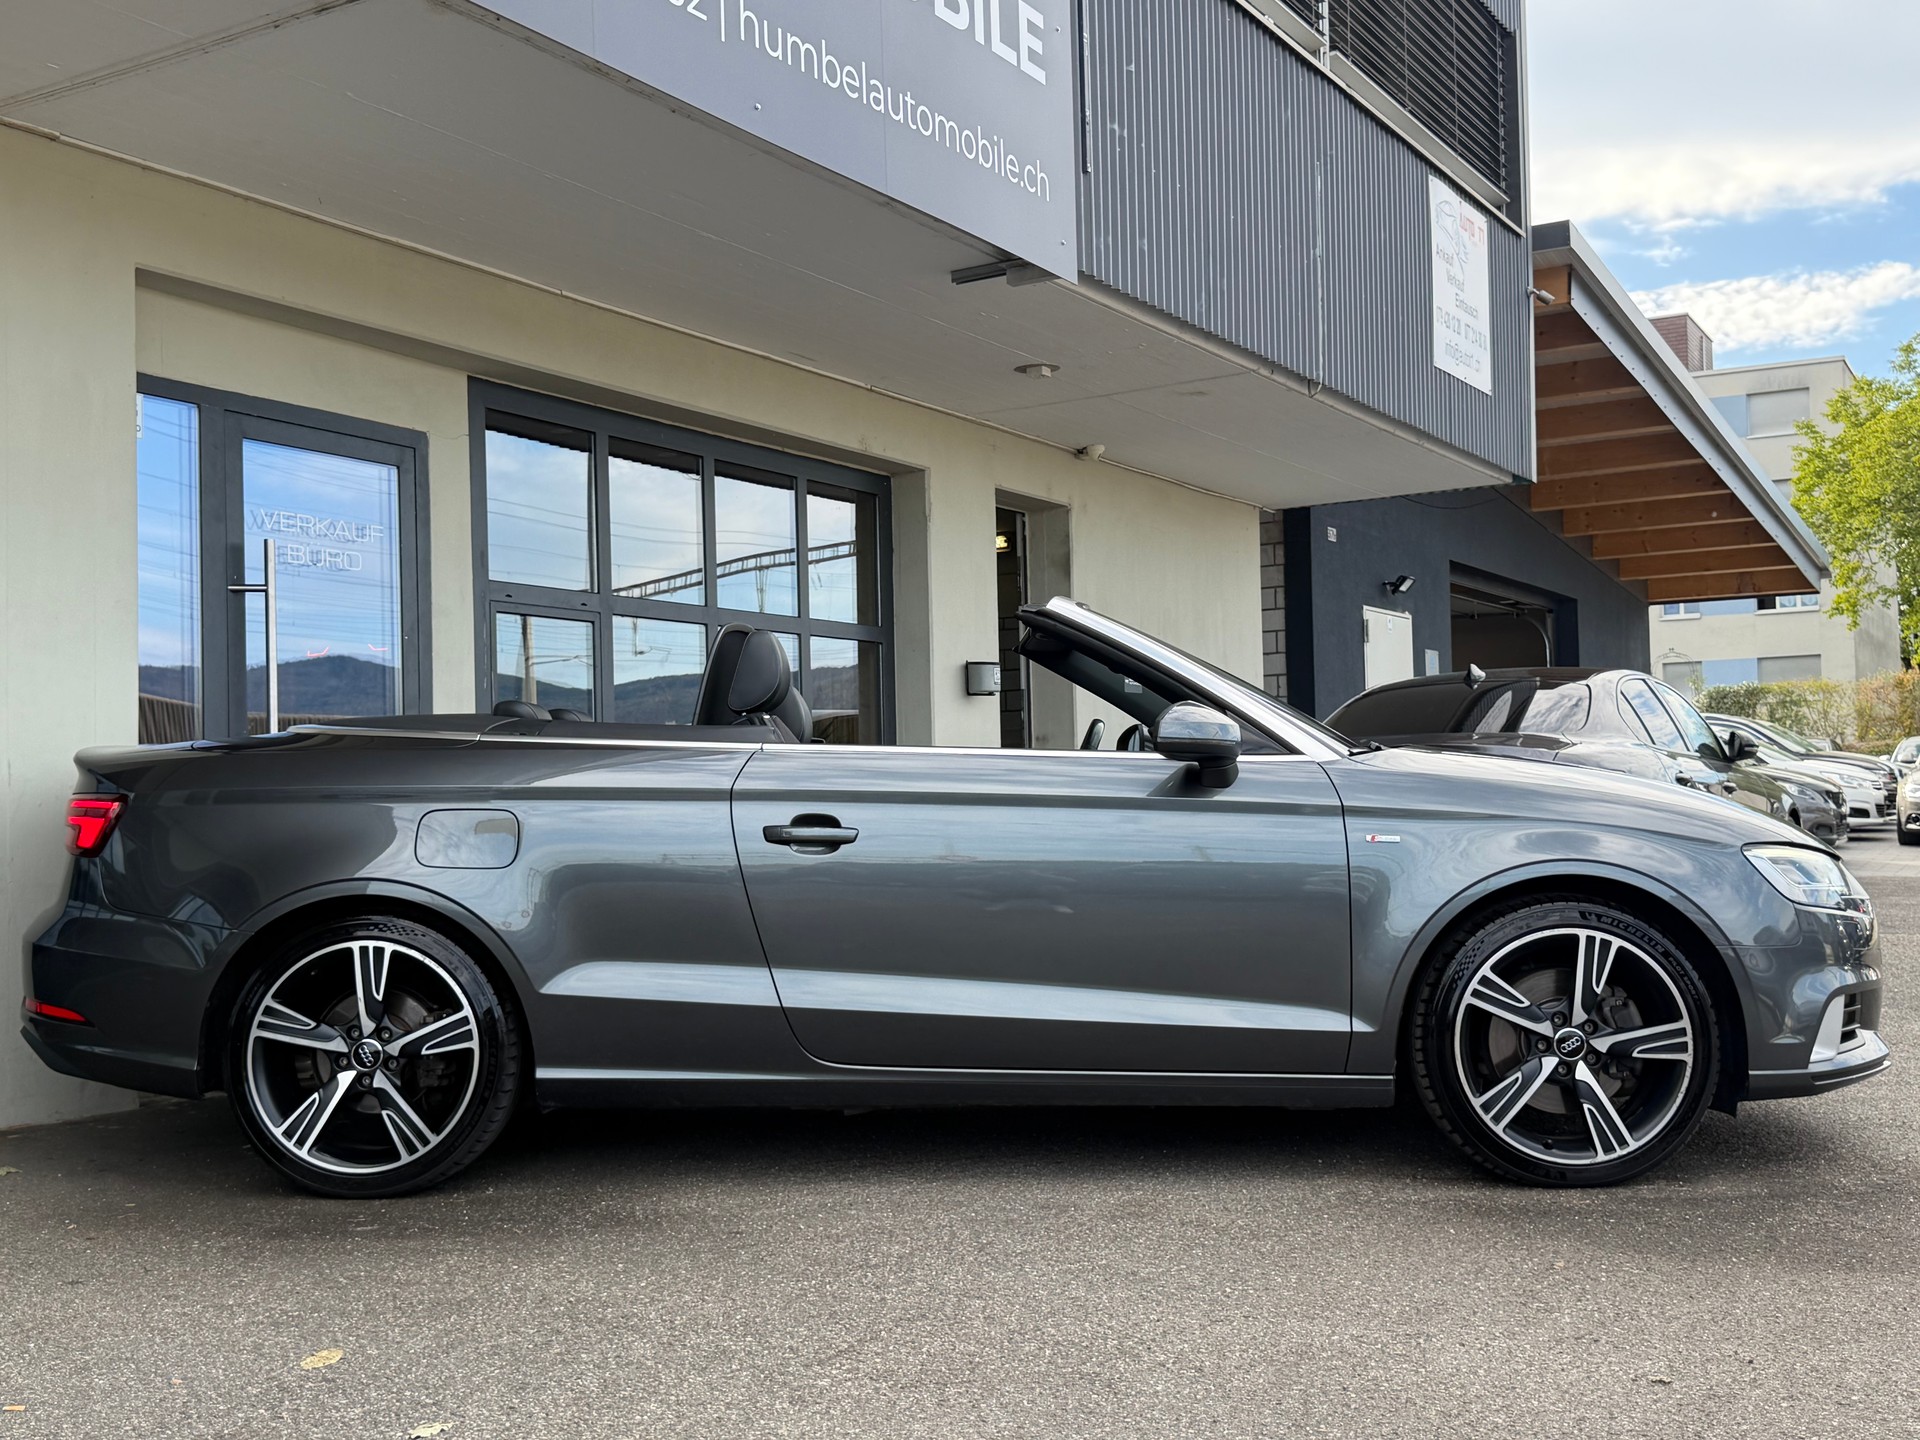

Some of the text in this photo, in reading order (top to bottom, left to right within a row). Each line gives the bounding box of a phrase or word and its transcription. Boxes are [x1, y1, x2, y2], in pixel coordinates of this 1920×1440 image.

[739, 0, 1050, 202] humbelautomobile.ch
[260, 508, 384, 543] VERKAUF
[287, 541, 362, 571] BÜRO
[1600, 915, 1665, 953] MICHELIN
